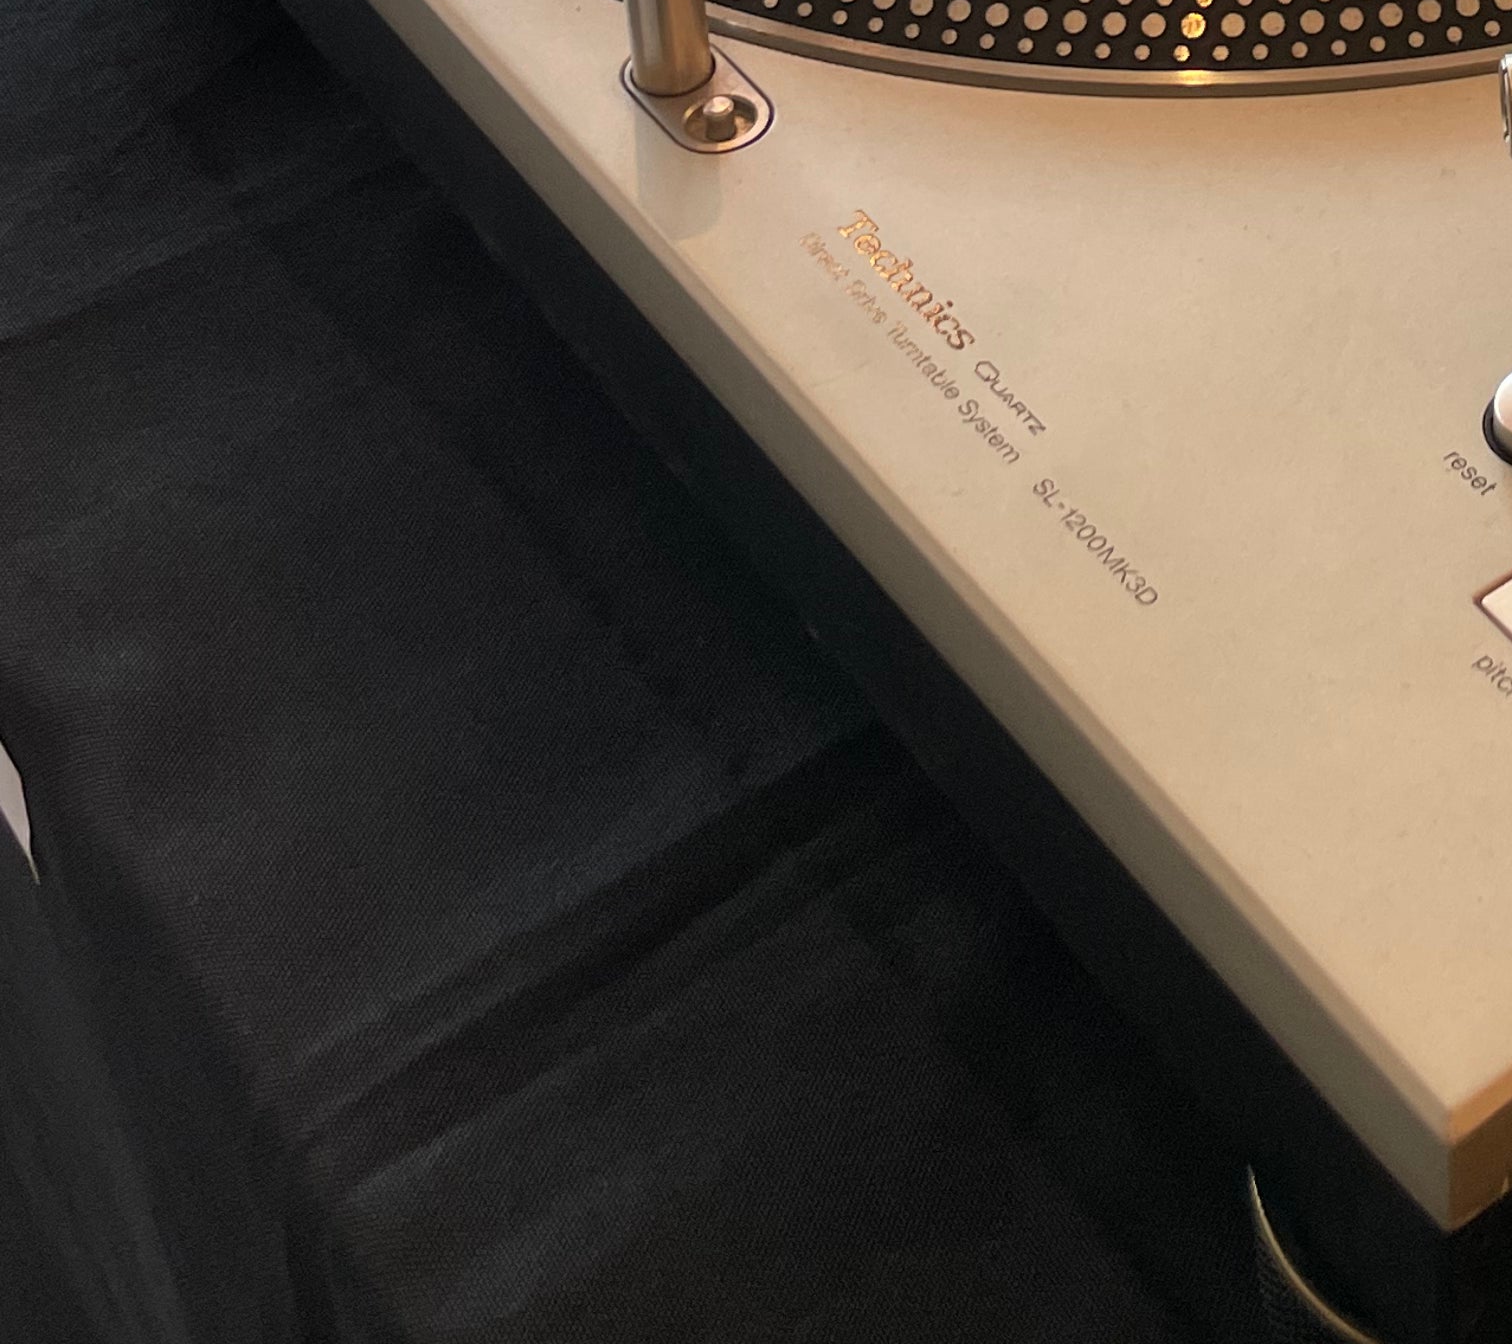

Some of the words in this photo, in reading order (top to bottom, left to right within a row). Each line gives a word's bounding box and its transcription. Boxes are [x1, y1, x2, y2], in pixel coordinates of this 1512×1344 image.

[838, 209, 975, 350] Technics
[888, 321, 960, 400] Turntable
[958, 398, 1020, 465] System
[1033, 477, 1159, 608] SL-1200MK3D
[1443, 447, 1498, 498] reset
